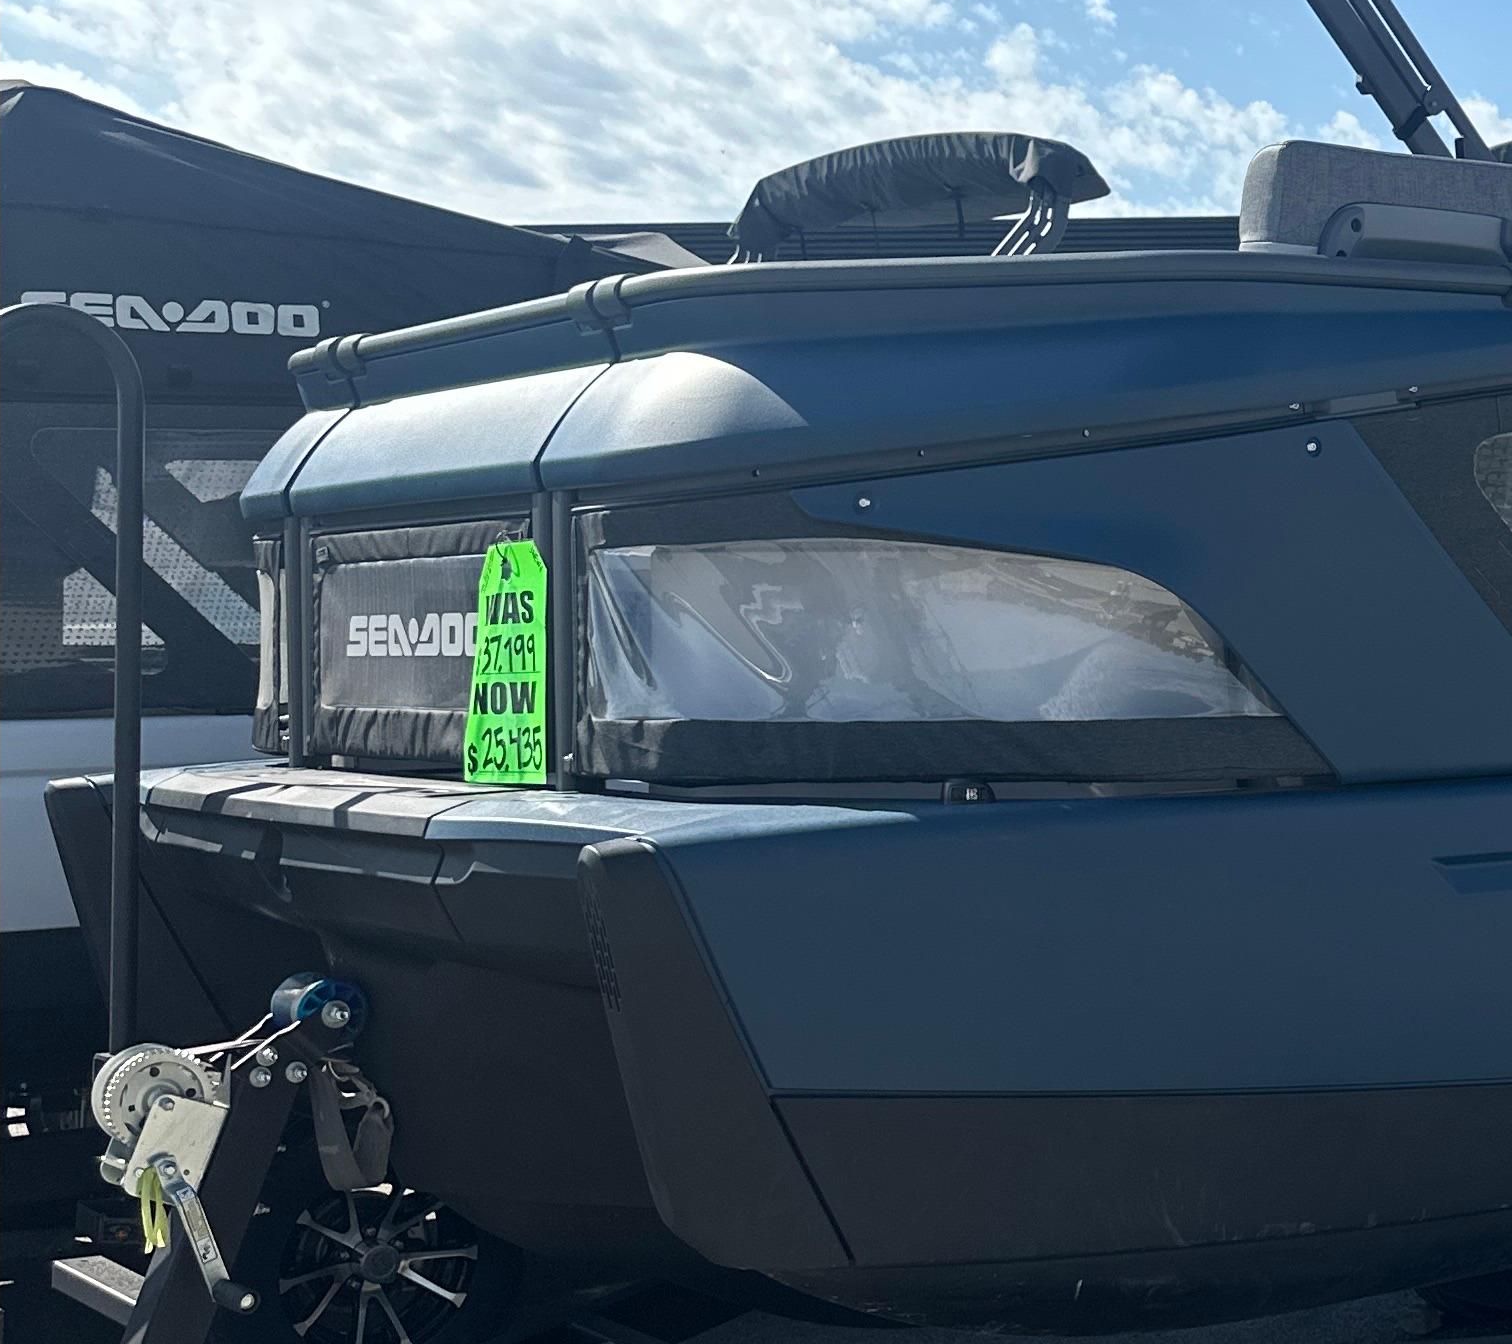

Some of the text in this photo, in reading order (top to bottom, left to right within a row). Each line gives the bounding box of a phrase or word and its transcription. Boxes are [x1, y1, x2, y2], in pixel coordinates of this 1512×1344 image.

[21, 291, 319, 337] EA•DOO
[485, 590, 534, 626] WAS
[473, 681, 537, 715] NOW
